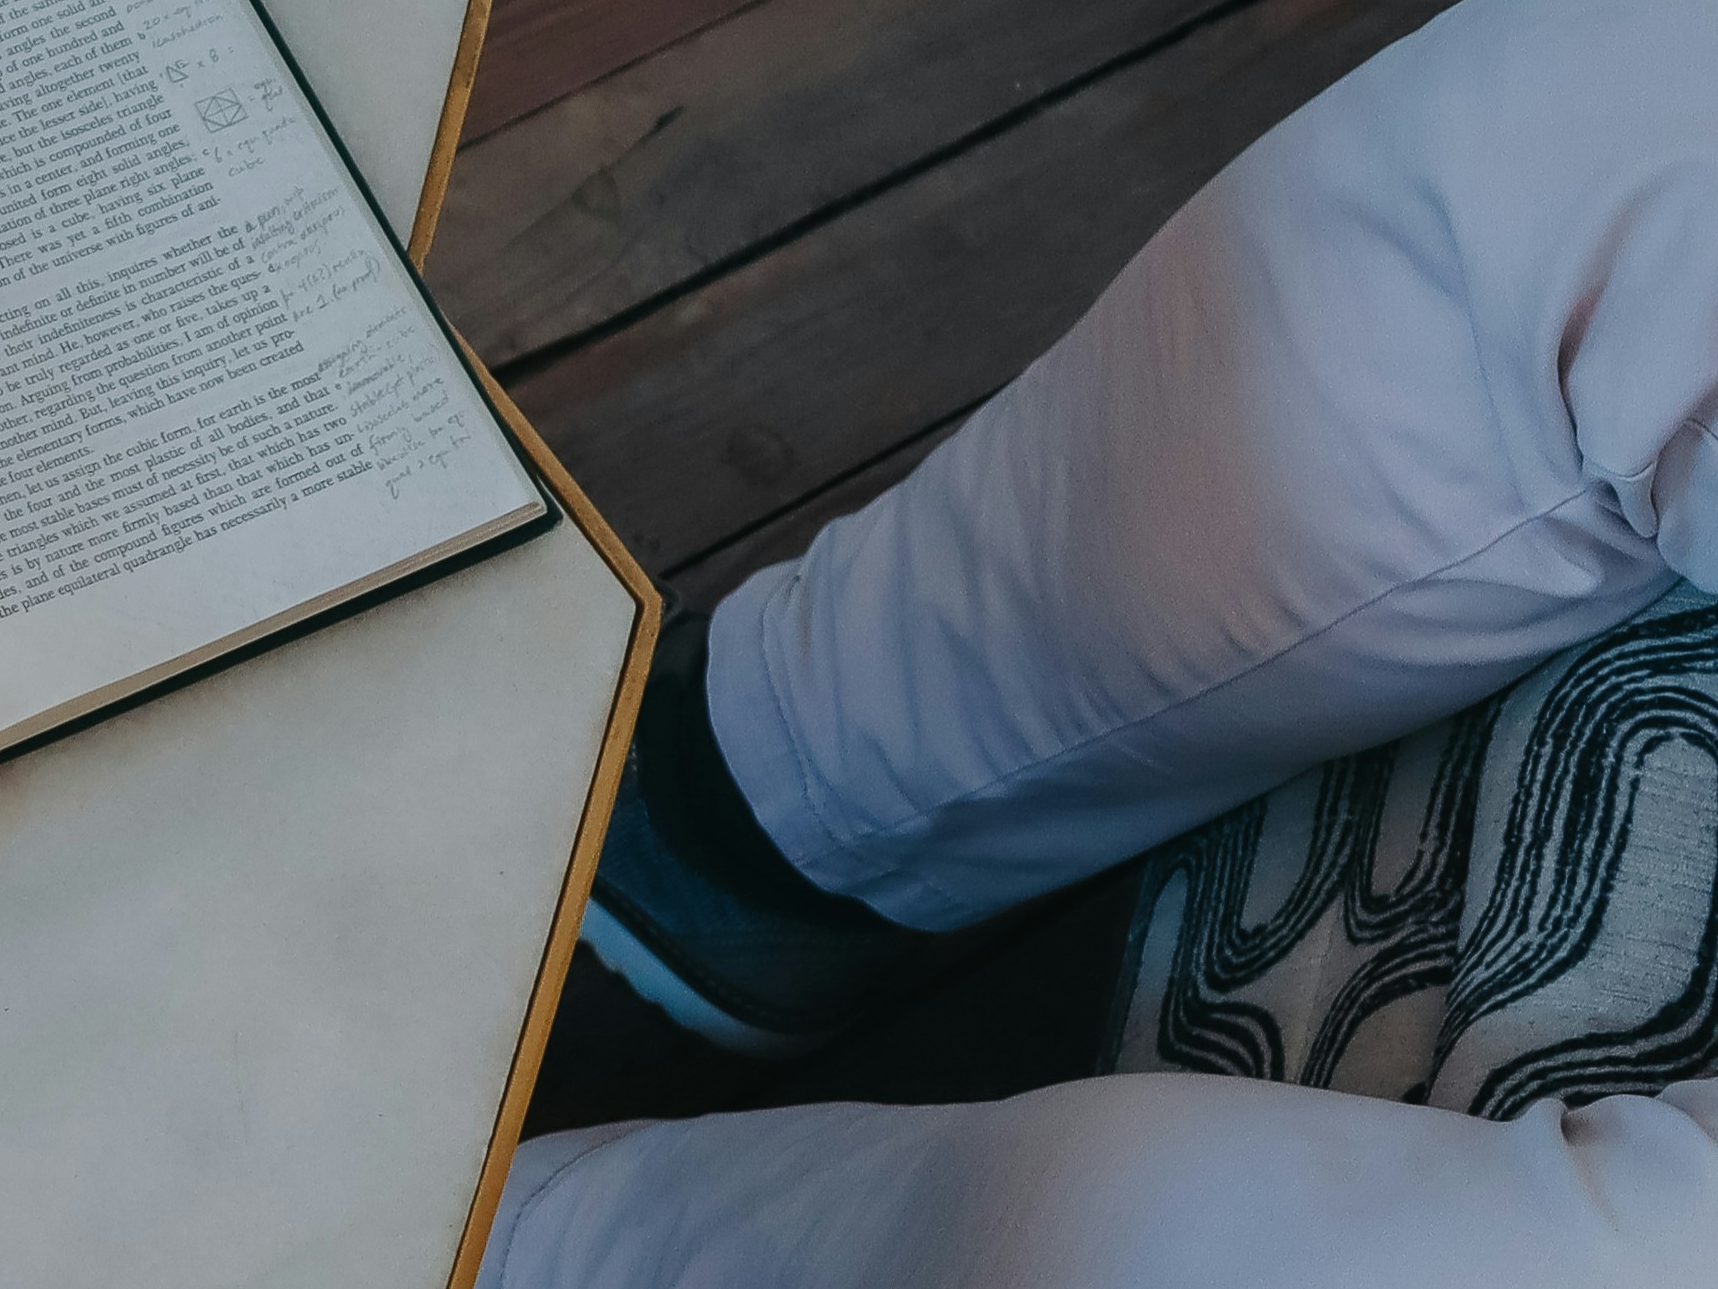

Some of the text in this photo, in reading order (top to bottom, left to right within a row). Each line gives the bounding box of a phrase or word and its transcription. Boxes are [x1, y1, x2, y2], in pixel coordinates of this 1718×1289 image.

[8, 467, 35, 483] four
[35, 446, 95, 473] elements.
[20, 590, 56, 613] plane
[57, 562, 121, 596] equilateral
[122, 536, 194, 573] quadrangle
[193, 526, 218, 542] has
[219, 496, 287, 531] necessarily
[290, 493, 300, 502] a
[301, 477, 335, 497] more
[336, 460, 374, 482] stable
